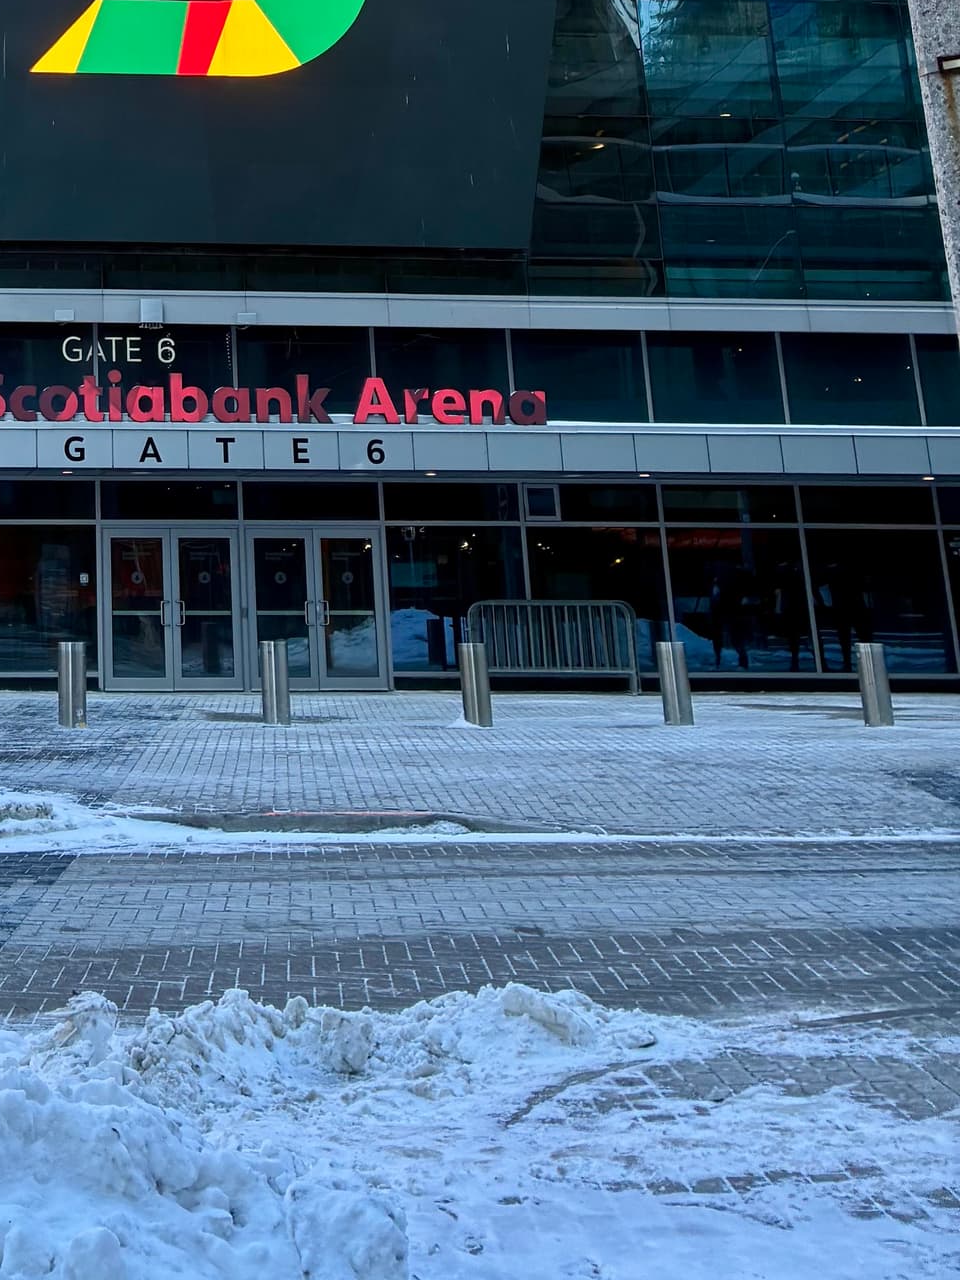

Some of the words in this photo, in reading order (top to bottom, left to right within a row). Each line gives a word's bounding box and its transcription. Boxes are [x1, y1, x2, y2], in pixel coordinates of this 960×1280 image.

[62, 335, 142, 363] GATE
[157, 337, 176, 364] 6
[353, 376, 547, 426] Arena
[366, 438, 386, 465] 6
